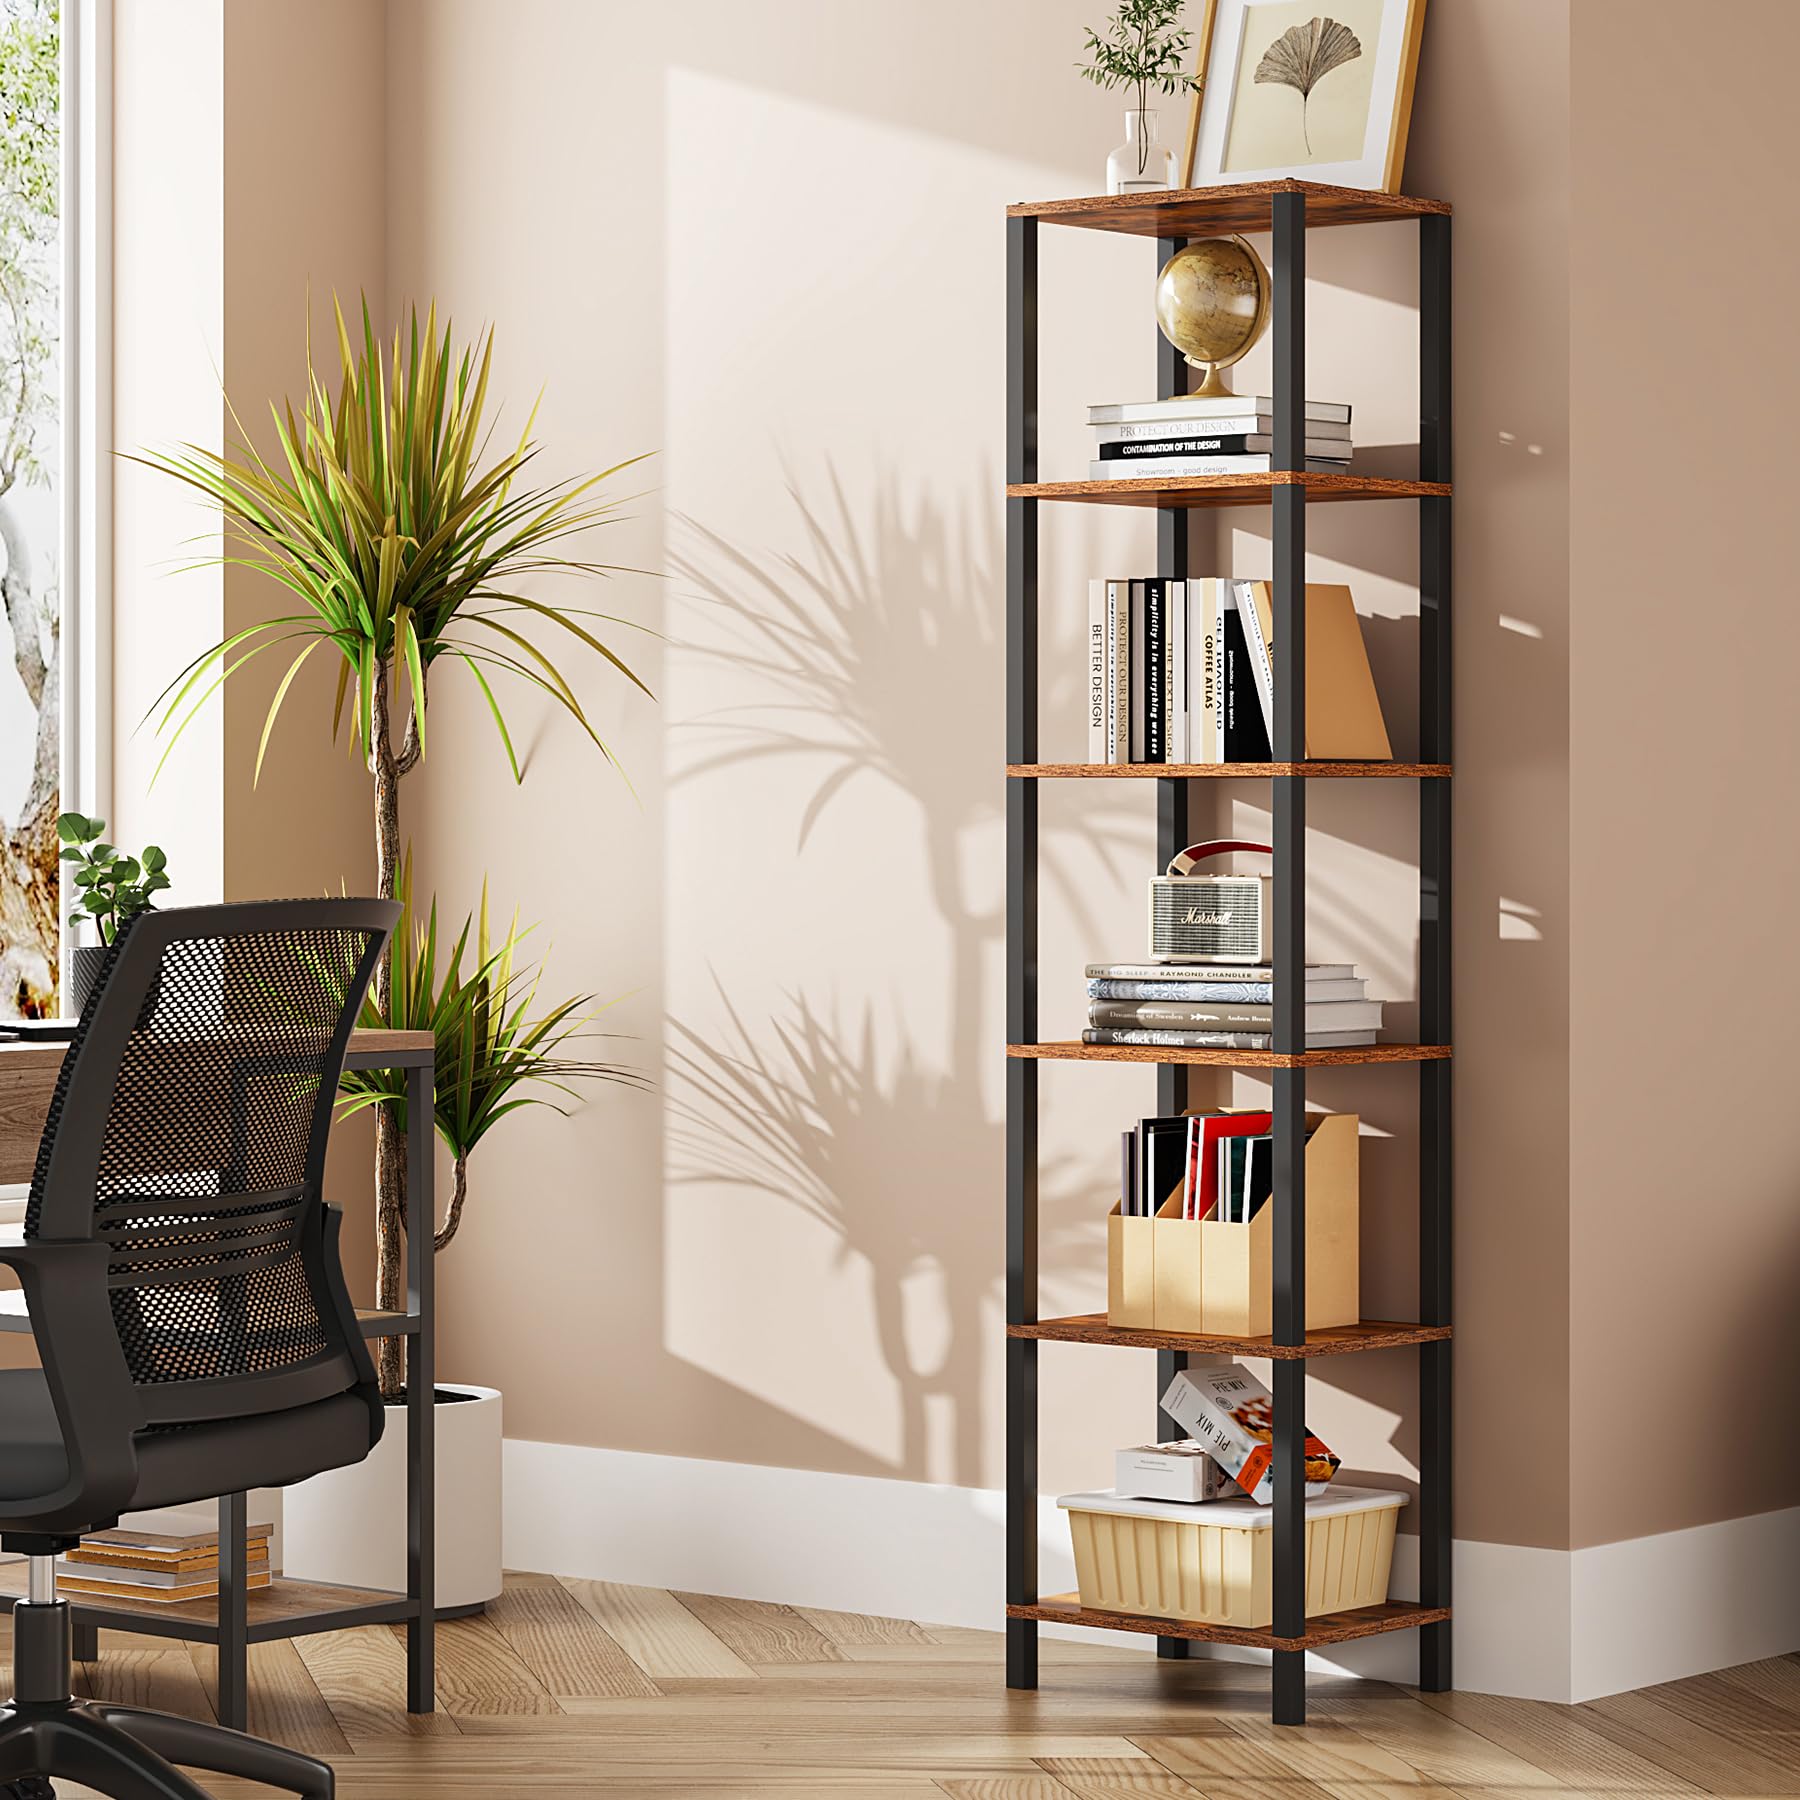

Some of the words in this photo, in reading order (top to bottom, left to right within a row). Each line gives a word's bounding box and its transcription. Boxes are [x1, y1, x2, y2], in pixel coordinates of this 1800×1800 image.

[1120, 424, 1167, 437] PROTECT
[1169, 422, 1194, 434] OUR
[1194, 421, 1236, 433] DESIGN
[1174, 442, 1184, 452] OF
[1183, 441, 1196, 451] THE
[1197, 440, 1221, 450] DESIGN
[1136, 467, 1176, 476] Showroom
[1182, 466, 1201, 475] good
[1203, 465, 1228, 475] design
[1150, 588, 1159, 638] simplicity
[1092, 624, 1102, 672] BETTER
[1119, 611, 1127, 666] PROTECT
[1151, 641, 1159, 650] is
[1151, 653, 1159, 662] in
[1205, 635, 1213, 673] COFFEE
[1119, 668, 1127, 695] OUR
[1150, 665, 1159, 719] everything
[1205, 677, 1213, 709] ATLAS
[1092, 676, 1102, 728] DESIGN
[1119, 698, 1127, 743] DESIGN
[1151, 722, 1158, 735] we
[1180, 906, 1233, 926] Marshall
[1112, 1031, 1150, 1045] Sherlock
[1152, 1032, 1185, 1046] Holmes
[1211, 1381, 1232, 1393] PIE
[1228, 1379, 1249, 1391] MIX
[1195, 1412, 1215, 1436] MIX
[1213, 1430, 1231, 1452] PIE
